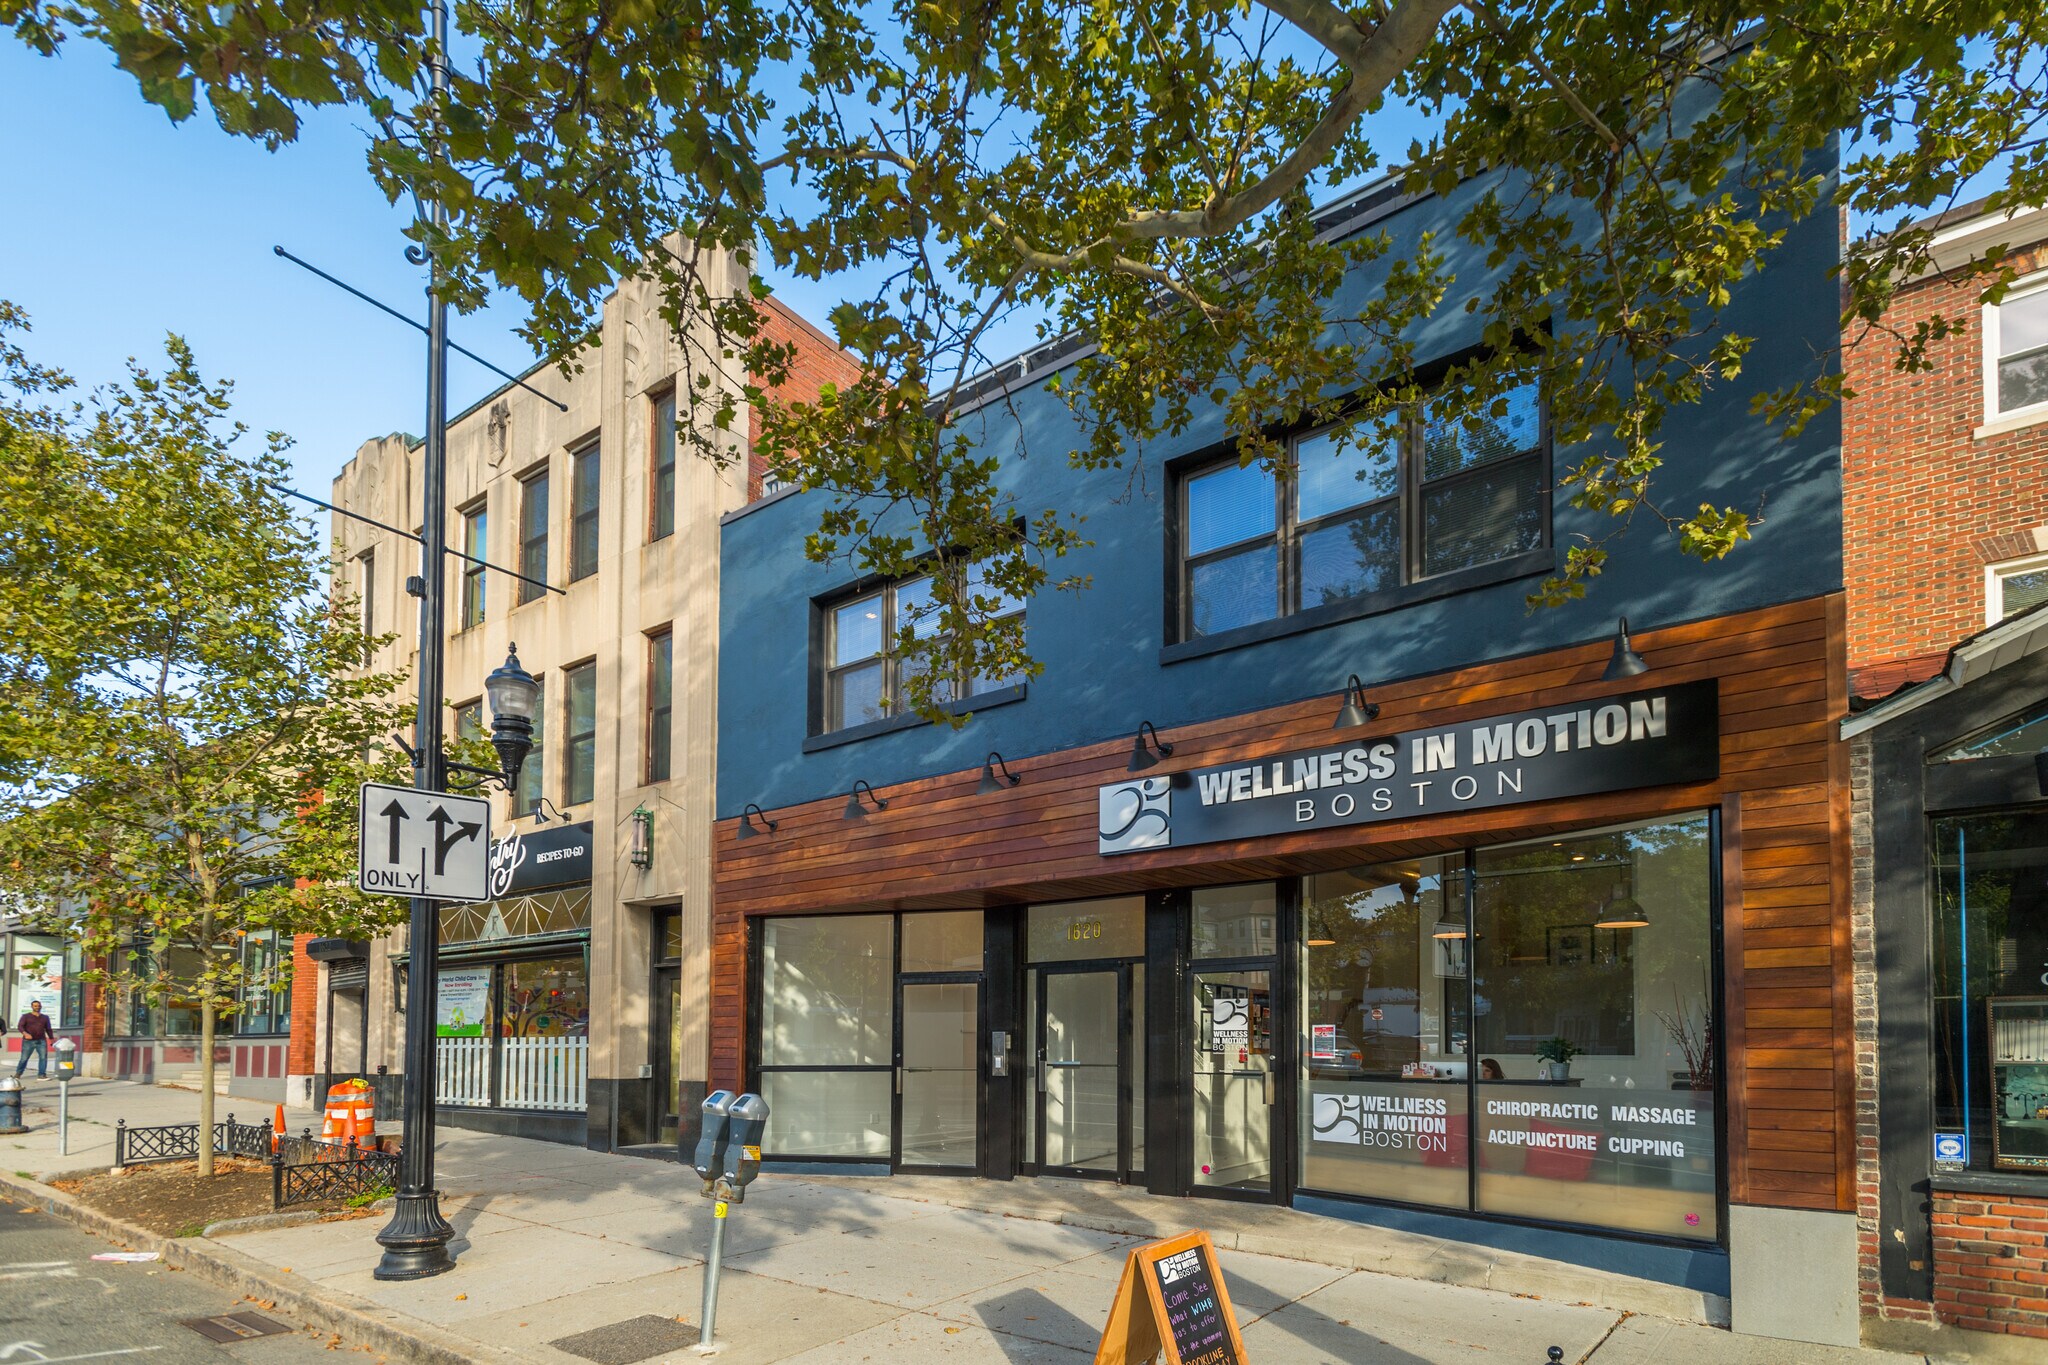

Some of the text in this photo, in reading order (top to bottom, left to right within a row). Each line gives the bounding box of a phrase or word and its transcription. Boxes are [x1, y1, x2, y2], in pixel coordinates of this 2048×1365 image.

[1198, 697, 1667, 806] WELLNESS IN MOTION
[1296, 768, 1523, 822] BOSTON
[536, 845, 584, 864] RECIPES TO-GO
[367, 869, 420, 889] ONLY
[1067, 922, 1101, 940] 1620
[1213, 1030, 1248, 1038] WELLNESS
[1362, 1096, 1446, 1115] WELLNESS
[1487, 1101, 1696, 1125] CHIROPRACTIC MASSAGE
[1363, 1114, 1446, 1134] IN MOTION
[1363, 1131, 1447, 1152] BOSTON
[1488, 1129, 1684, 1157] ACUPUNCTURE CUPPING
[1174, 1249, 1197, 1263] WELLNESS
[1176, 1256, 1199, 1271] IN MOTION
[1178, 1264, 1201, 1279] BOSTON
[1163, 1281, 1209, 1309] Come See
[1191, 1298, 1214, 1316] WIMB
[1190, 1323, 1198, 1332] to
